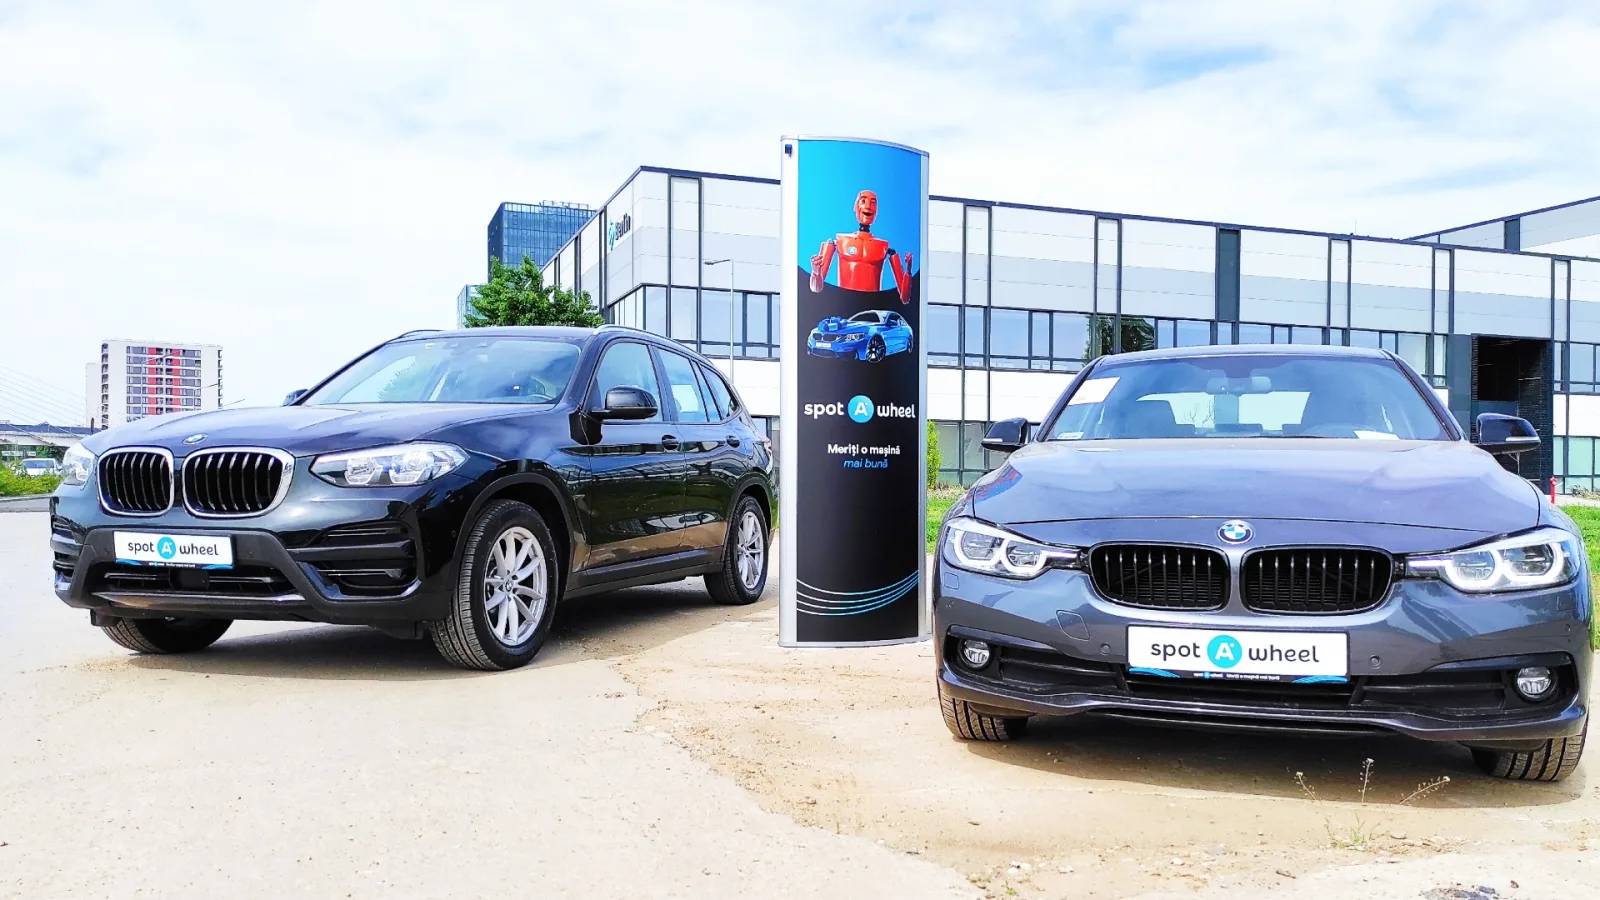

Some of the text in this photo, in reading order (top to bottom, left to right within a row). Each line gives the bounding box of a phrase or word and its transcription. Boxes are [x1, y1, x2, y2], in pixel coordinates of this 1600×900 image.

[804, 402, 844, 419] spot
[877, 402, 916, 418] wheel
[843, 458, 888, 469] mai bună
[127, 541, 154, 555] spot
[179, 543, 219, 556] wheel
[1150, 642, 1201, 661] spot
[1248, 644, 1320, 663] wheel
